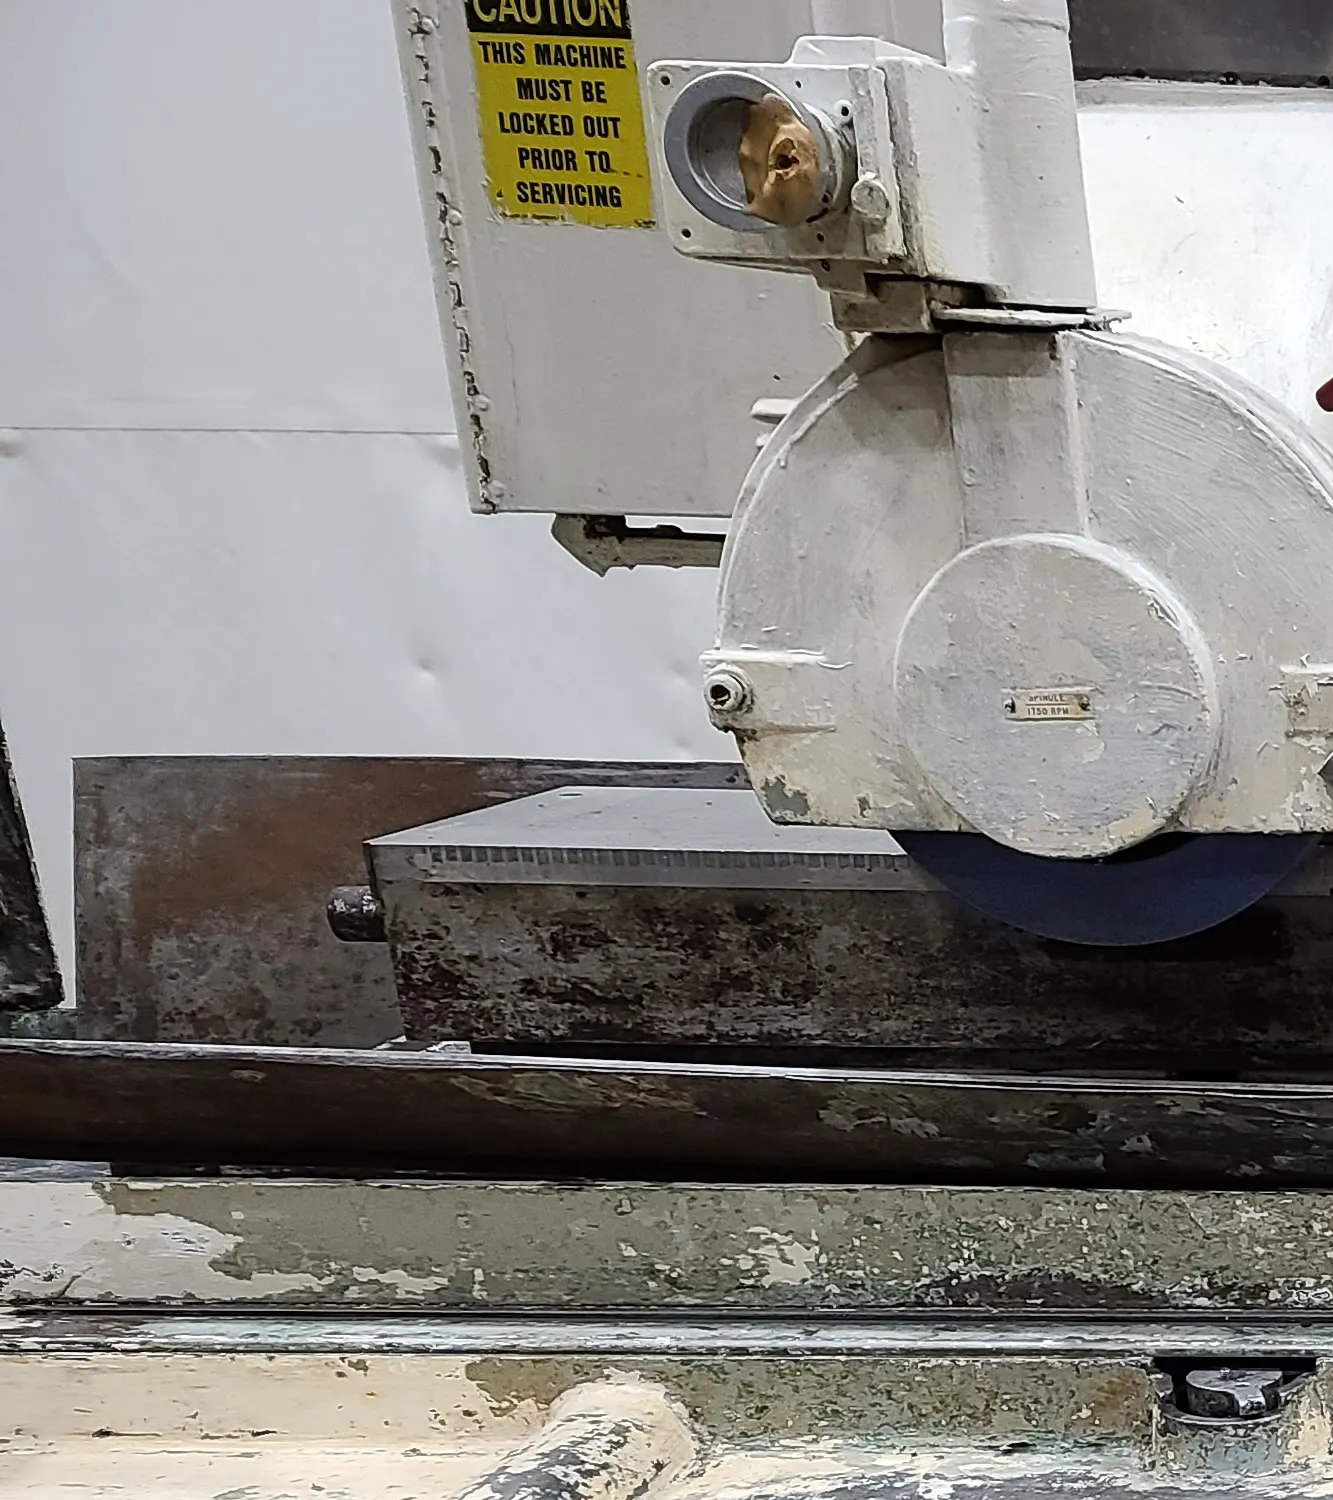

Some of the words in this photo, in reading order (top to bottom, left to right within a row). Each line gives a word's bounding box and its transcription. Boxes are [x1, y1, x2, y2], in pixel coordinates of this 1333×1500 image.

[473, 0, 623, 27] CAUTION
[478, 41, 526, 65] THIS
[534, 43, 627, 69] MACHINE
[516, 77, 572, 102] MUST
[581, 80, 607, 103] BE
[498, 111, 574, 137] LOCKED
[583, 115, 621, 139] OUT
[517, 147, 578, 172] PRIOR
[585, 150, 612, 174] TO
[516, 181, 622, 208] SERVICING
[1027, 707, 1048, 715] 1750
[1051, 707, 1069, 715] RPM
